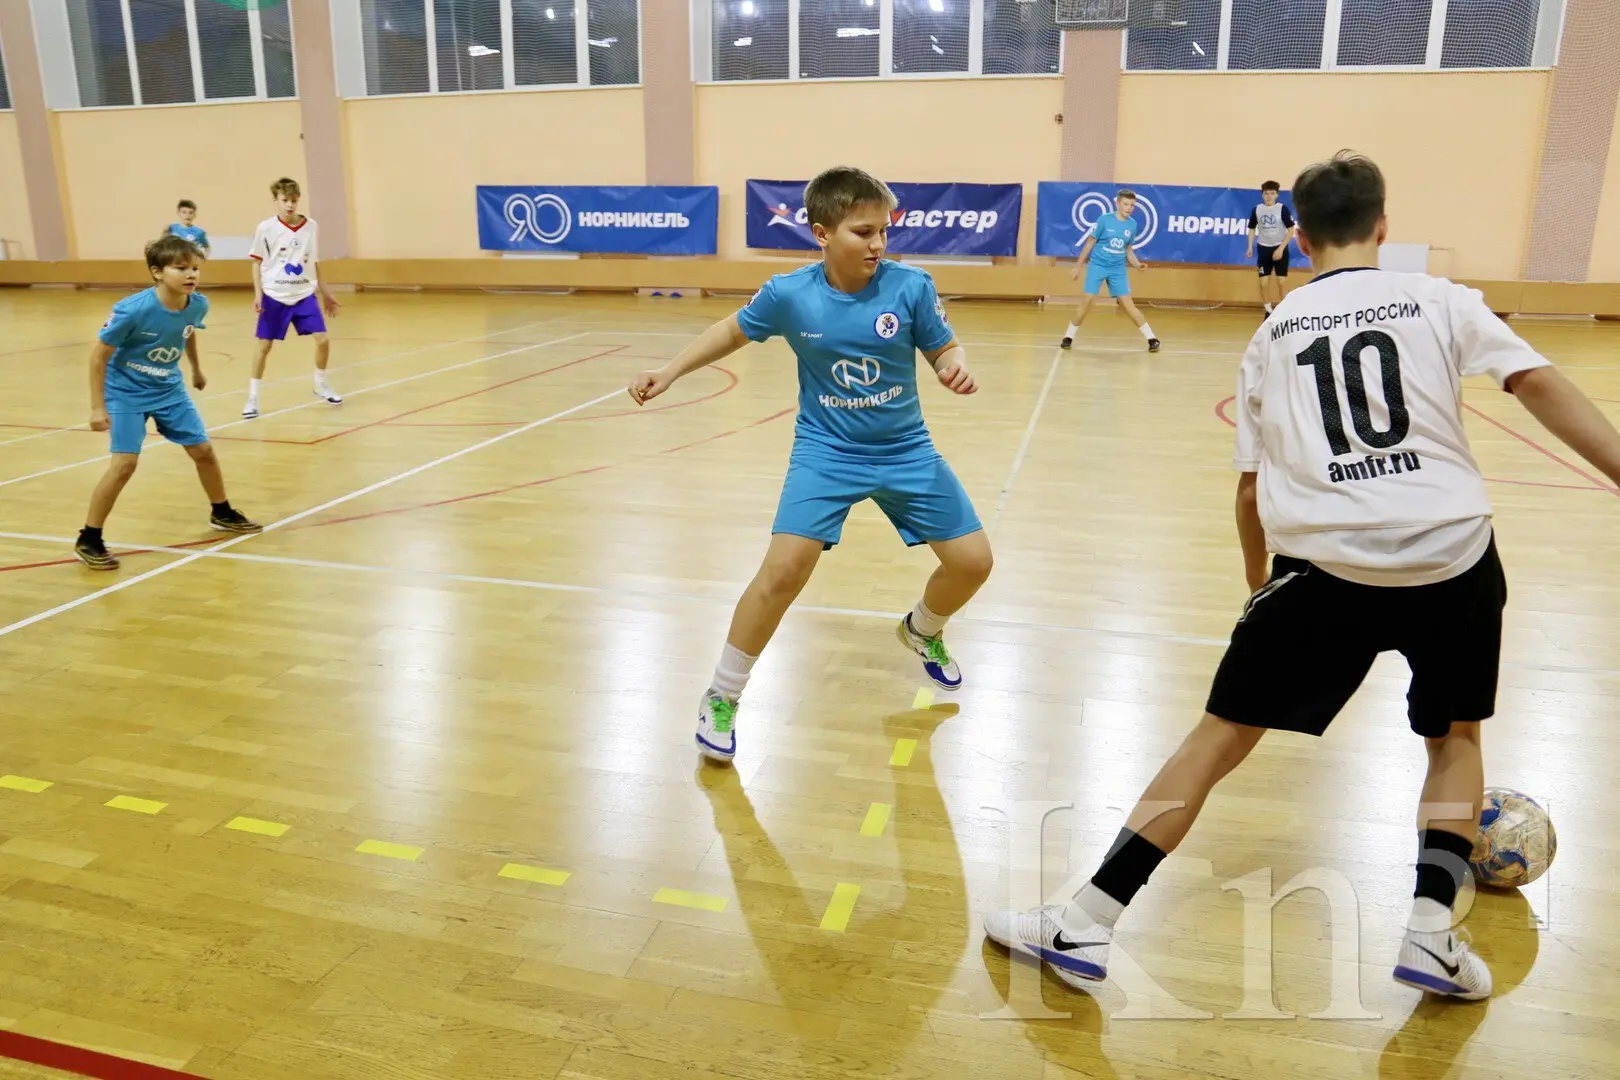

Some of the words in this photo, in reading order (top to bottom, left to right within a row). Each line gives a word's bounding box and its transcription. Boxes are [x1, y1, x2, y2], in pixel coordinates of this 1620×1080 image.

[503, 193, 571, 244] 90
[578, 211, 690, 229] НОРНИКЕЛЬ
[1271, 313, 1351, 341] МИНСПОРТ
[1355, 302, 1421, 327] РОССИИ
[1296, 330, 1410, 456] 10
[1328, 451, 1422, 483] amfr.ru
